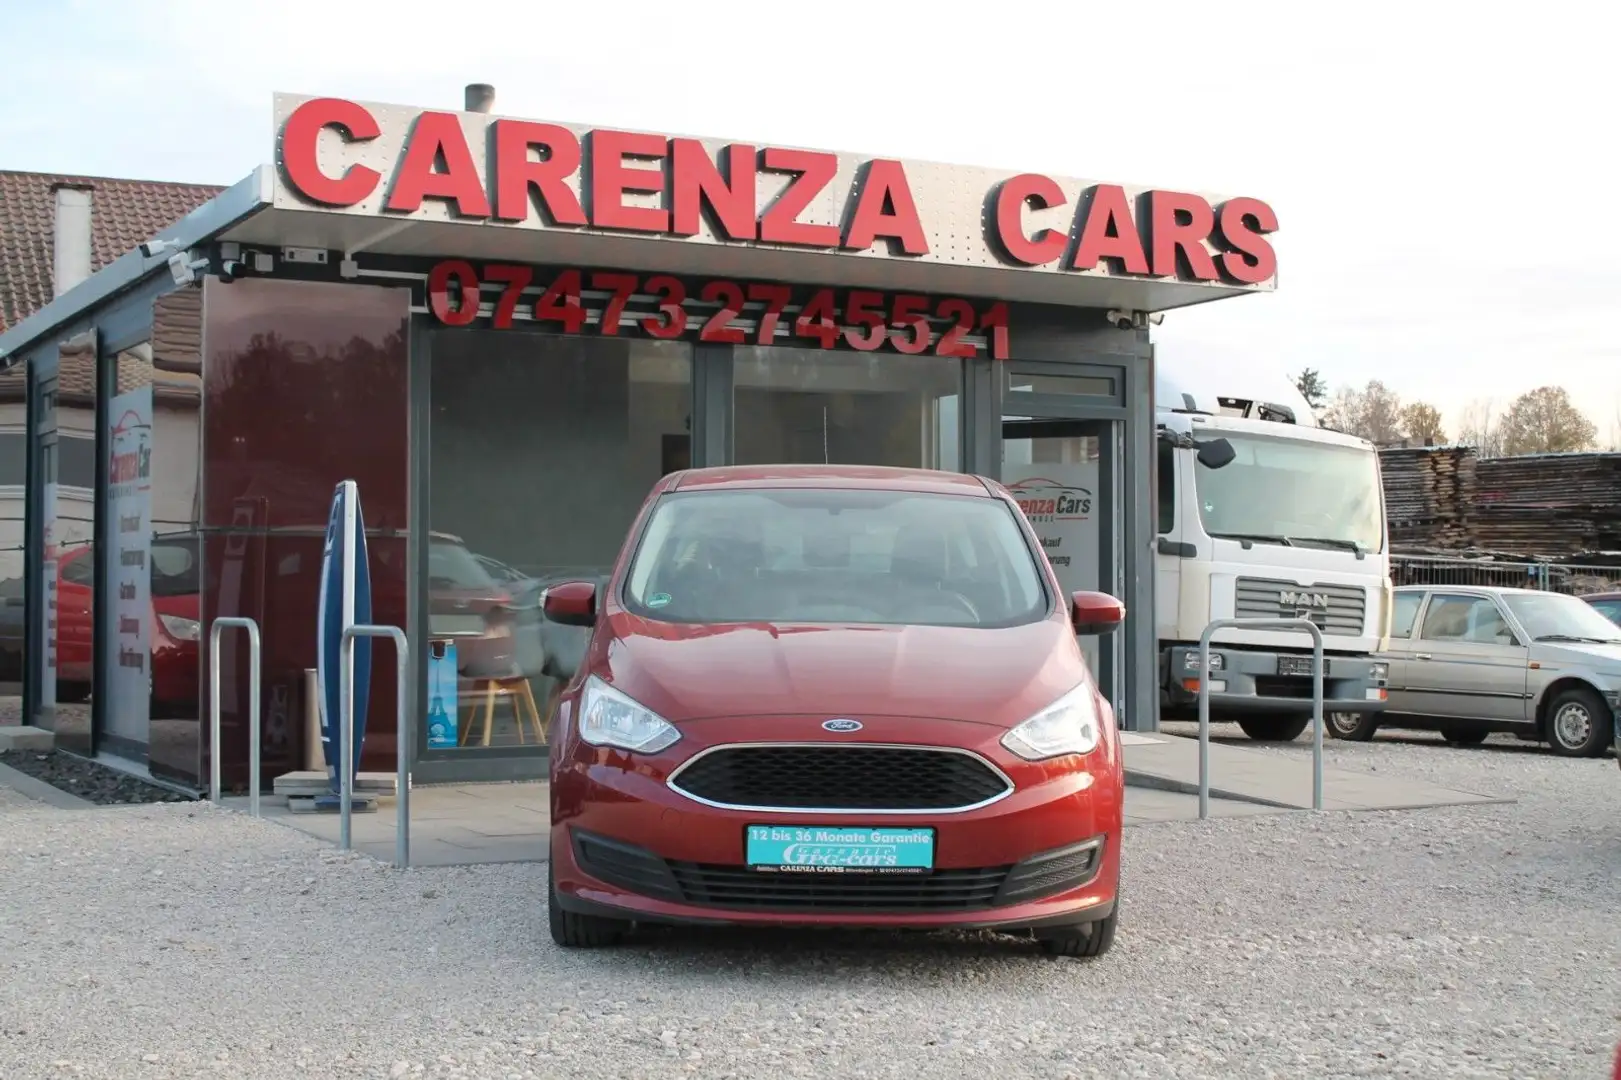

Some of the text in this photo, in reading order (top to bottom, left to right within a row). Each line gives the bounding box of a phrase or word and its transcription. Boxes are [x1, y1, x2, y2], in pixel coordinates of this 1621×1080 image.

[281, 98, 1279, 285] CARENZA CARS
[1056, 495, 1091, 514] Cars
[1280, 591, 1328, 607] MAN
[752, 829, 930, 844] 12 bis 36 Monate Garantie
[780, 865, 816, 873] CARENZA
